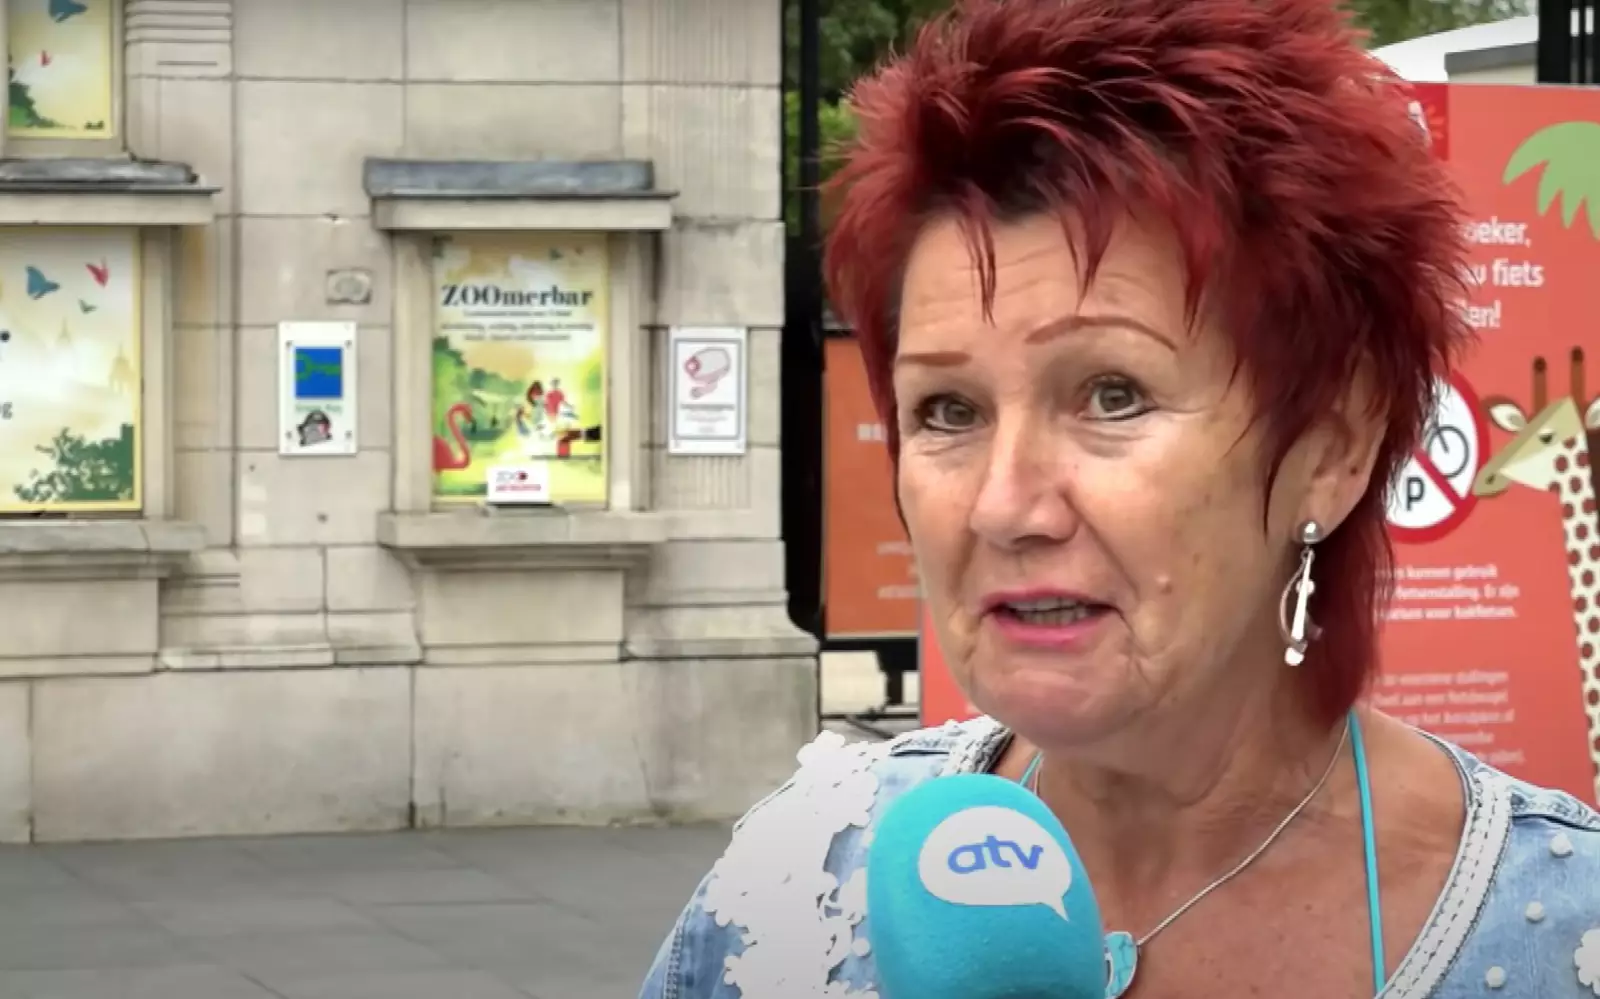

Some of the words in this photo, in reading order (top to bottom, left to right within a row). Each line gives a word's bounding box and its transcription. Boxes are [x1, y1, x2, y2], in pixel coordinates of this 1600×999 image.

[1461, 215, 1532, 249] oeker,
[1492, 257, 1544, 288] fiets
[441, 283, 594, 307] ZOOmerbar
[1406, 476, 1425, 512] P
[948, 835, 1044, 874] atv
